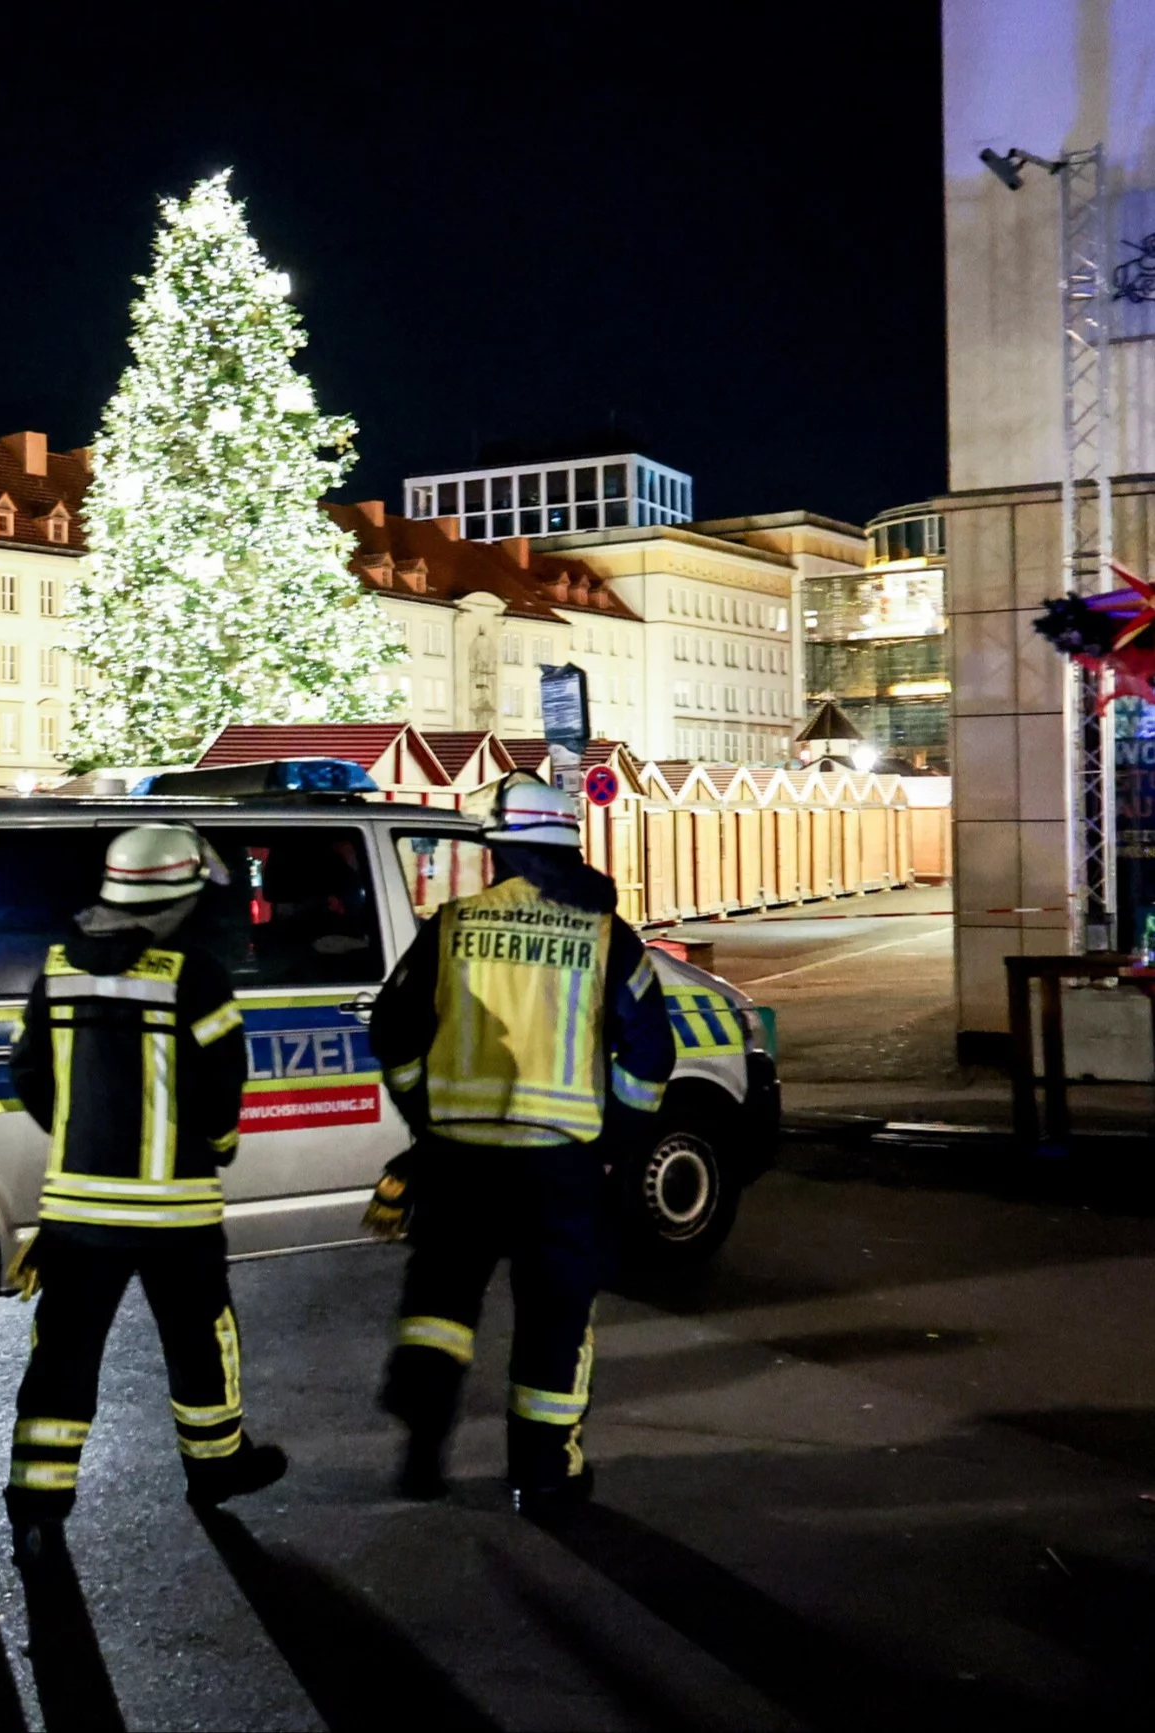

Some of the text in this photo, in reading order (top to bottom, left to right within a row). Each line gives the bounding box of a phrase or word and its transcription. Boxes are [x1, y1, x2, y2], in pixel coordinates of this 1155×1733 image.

[457, 907, 594, 931] Einsatzleiter
[451, 931, 593, 969] FEUERWEHR
[246, 1031, 355, 1080] LIZEI
[239, 1097, 375, 1121] HWUCHSFAHNDUNG.DE
